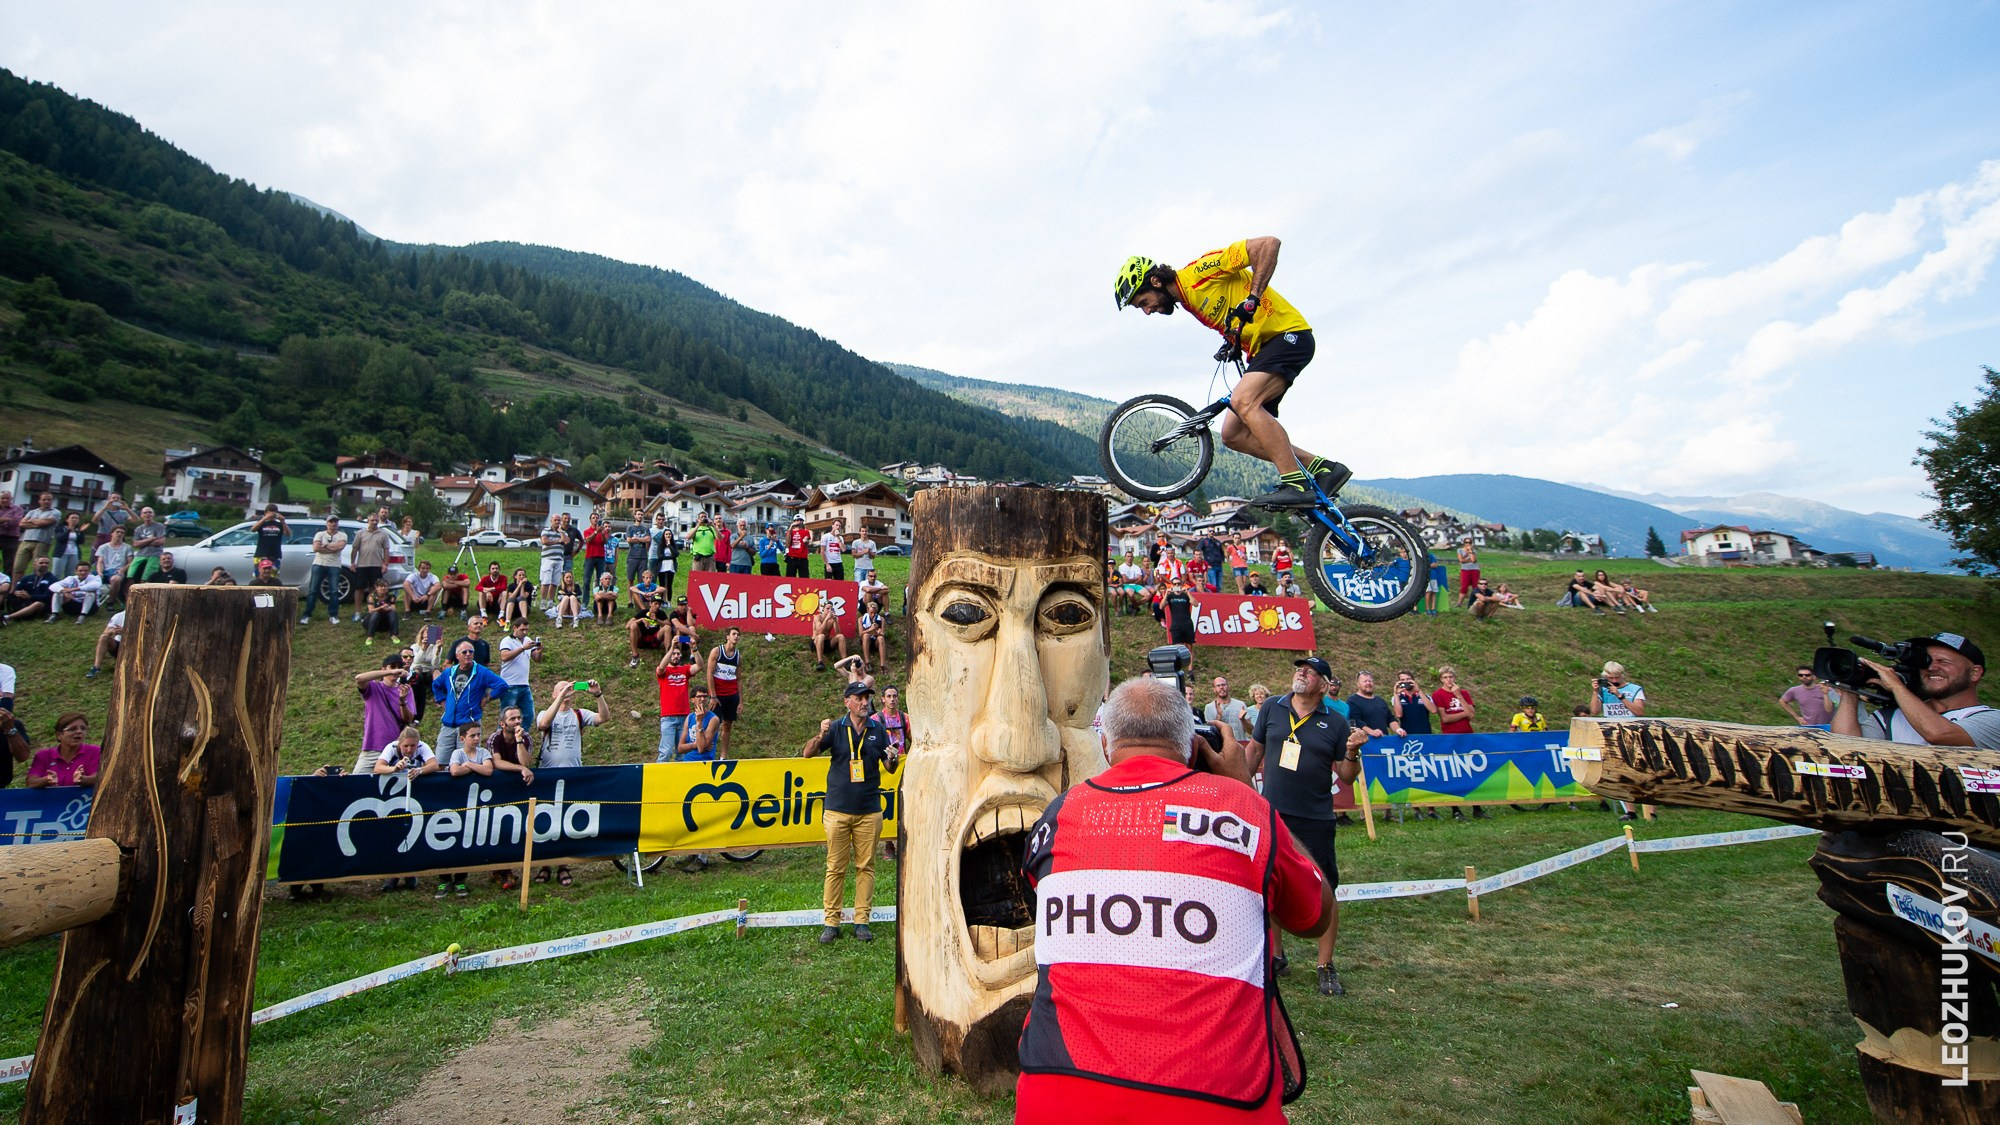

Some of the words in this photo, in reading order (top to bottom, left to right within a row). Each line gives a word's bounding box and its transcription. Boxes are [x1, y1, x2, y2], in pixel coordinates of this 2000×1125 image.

[699, 584, 748, 622] Val
[751, 598, 772, 618] di
[1223, 616, 1242, 633] di
[1239, 601, 1303, 634] Sole
[1381, 748, 1488, 782] TRENTINO
[336, 779, 601, 857] Melinda
[1181, 812, 1251, 848] UCI
[1046, 893, 1218, 945] PHOTO
[1892, 893, 1944, 930] TRENTINO
